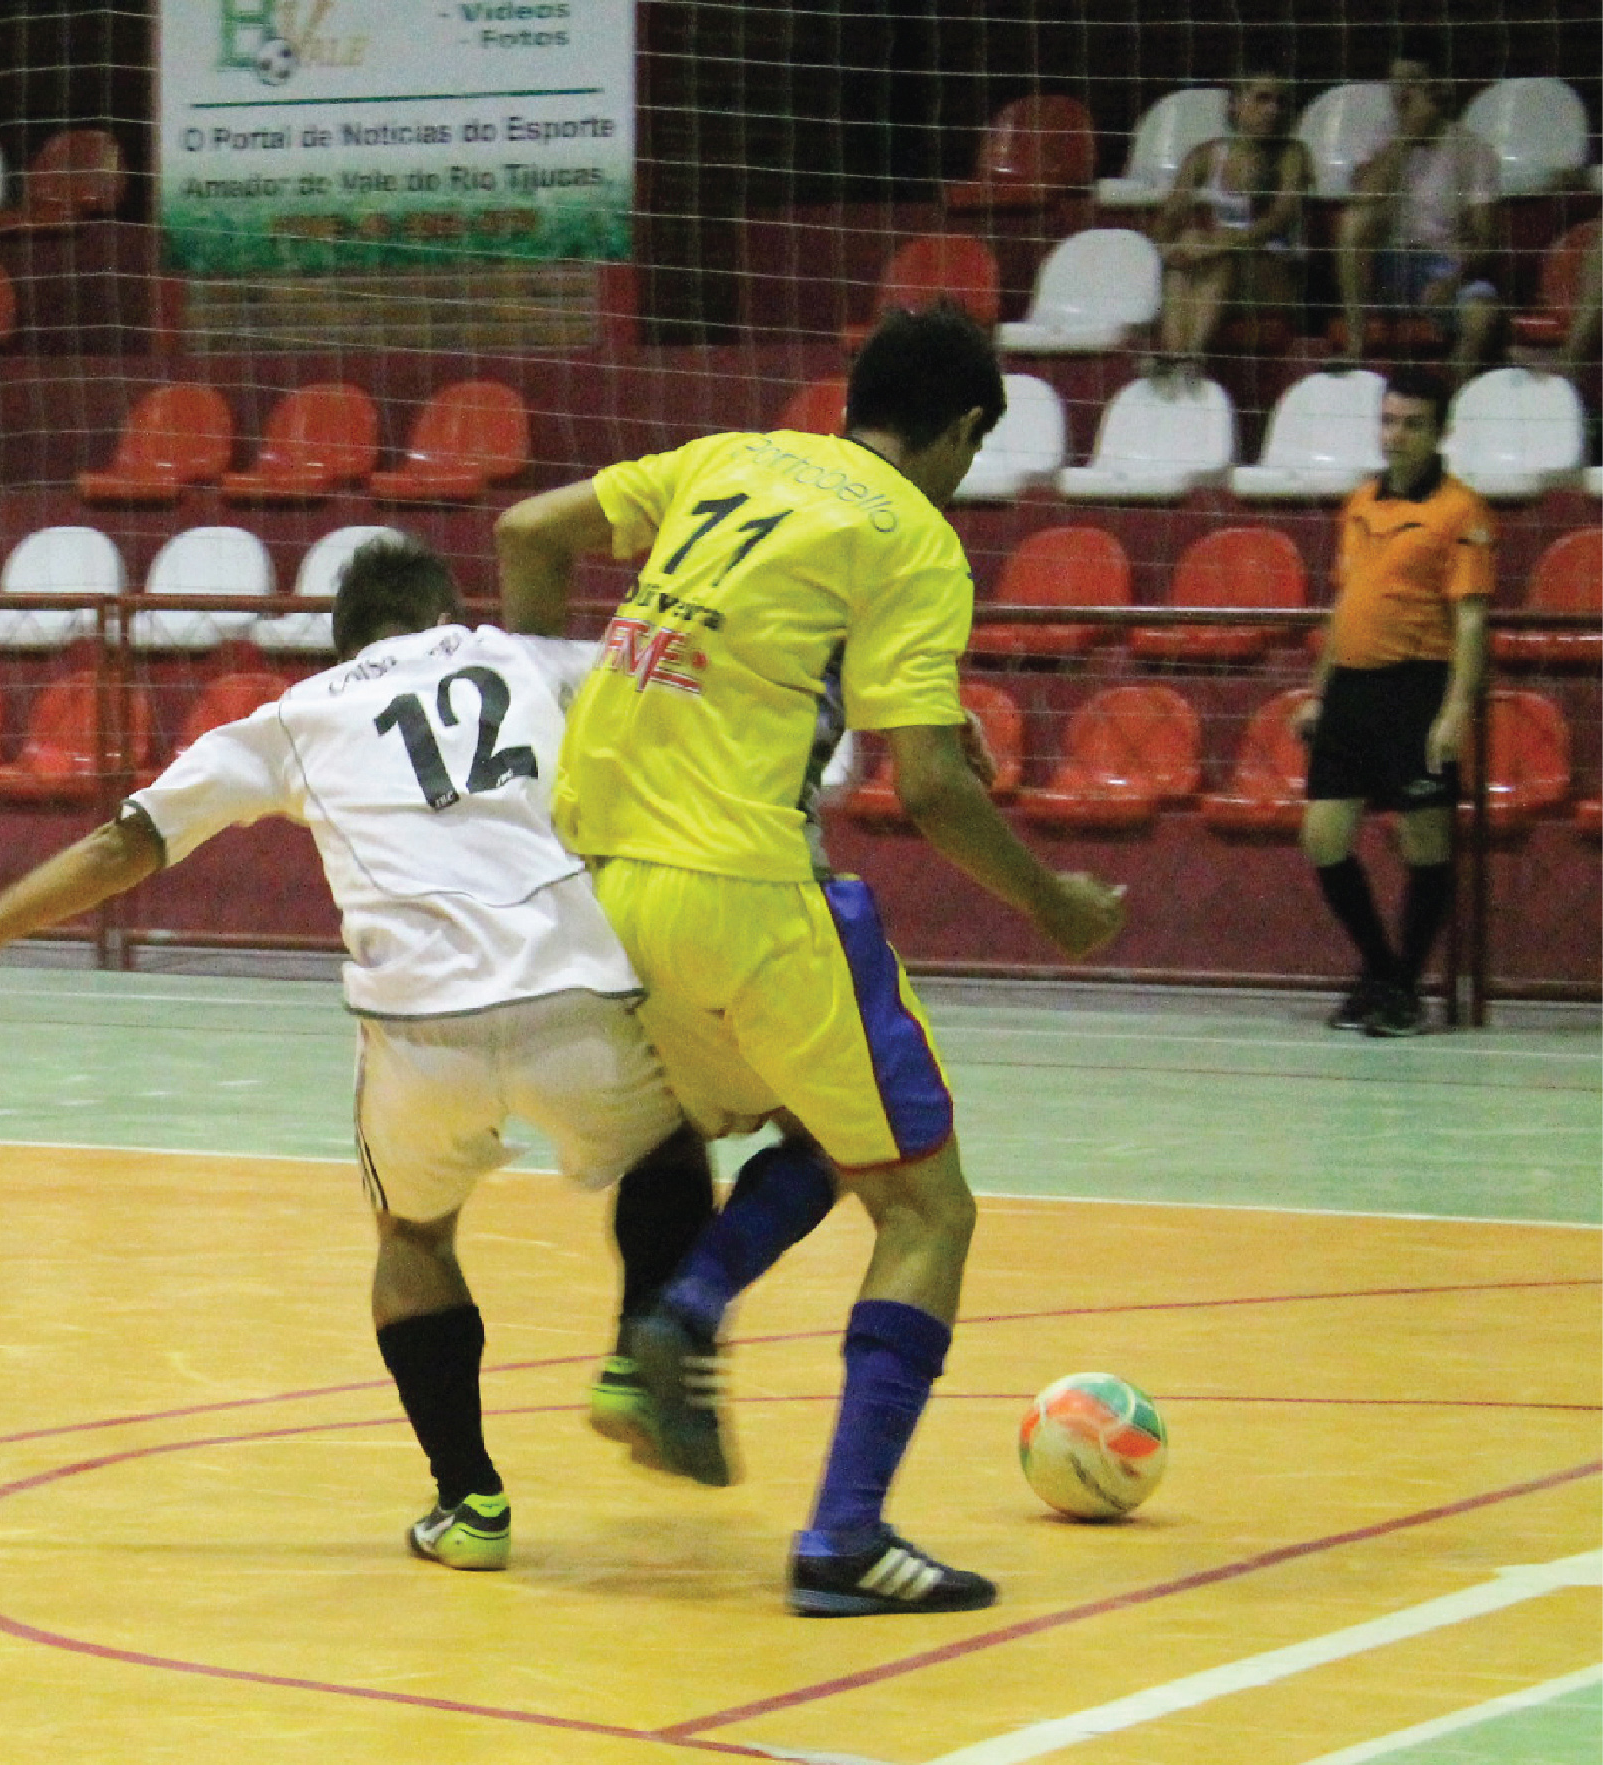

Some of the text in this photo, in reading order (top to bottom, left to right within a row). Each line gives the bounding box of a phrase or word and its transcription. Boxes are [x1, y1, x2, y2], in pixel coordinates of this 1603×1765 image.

[481, 29, 570, 49] Fotos
[182, 127, 204, 152] O
[212, 124, 292, 150] Portal
[301, 124, 332, 148] de
[463, 119, 496, 142] do
[506, 115, 616, 145] Esporte
[182, 172, 292, 199] Amador
[341, 168, 397, 194] Vale
[406, 166, 440, 192] do
[450, 164, 497, 192] Rio
[663, 492, 794, 588] 11
[373, 665, 539, 811] 12
